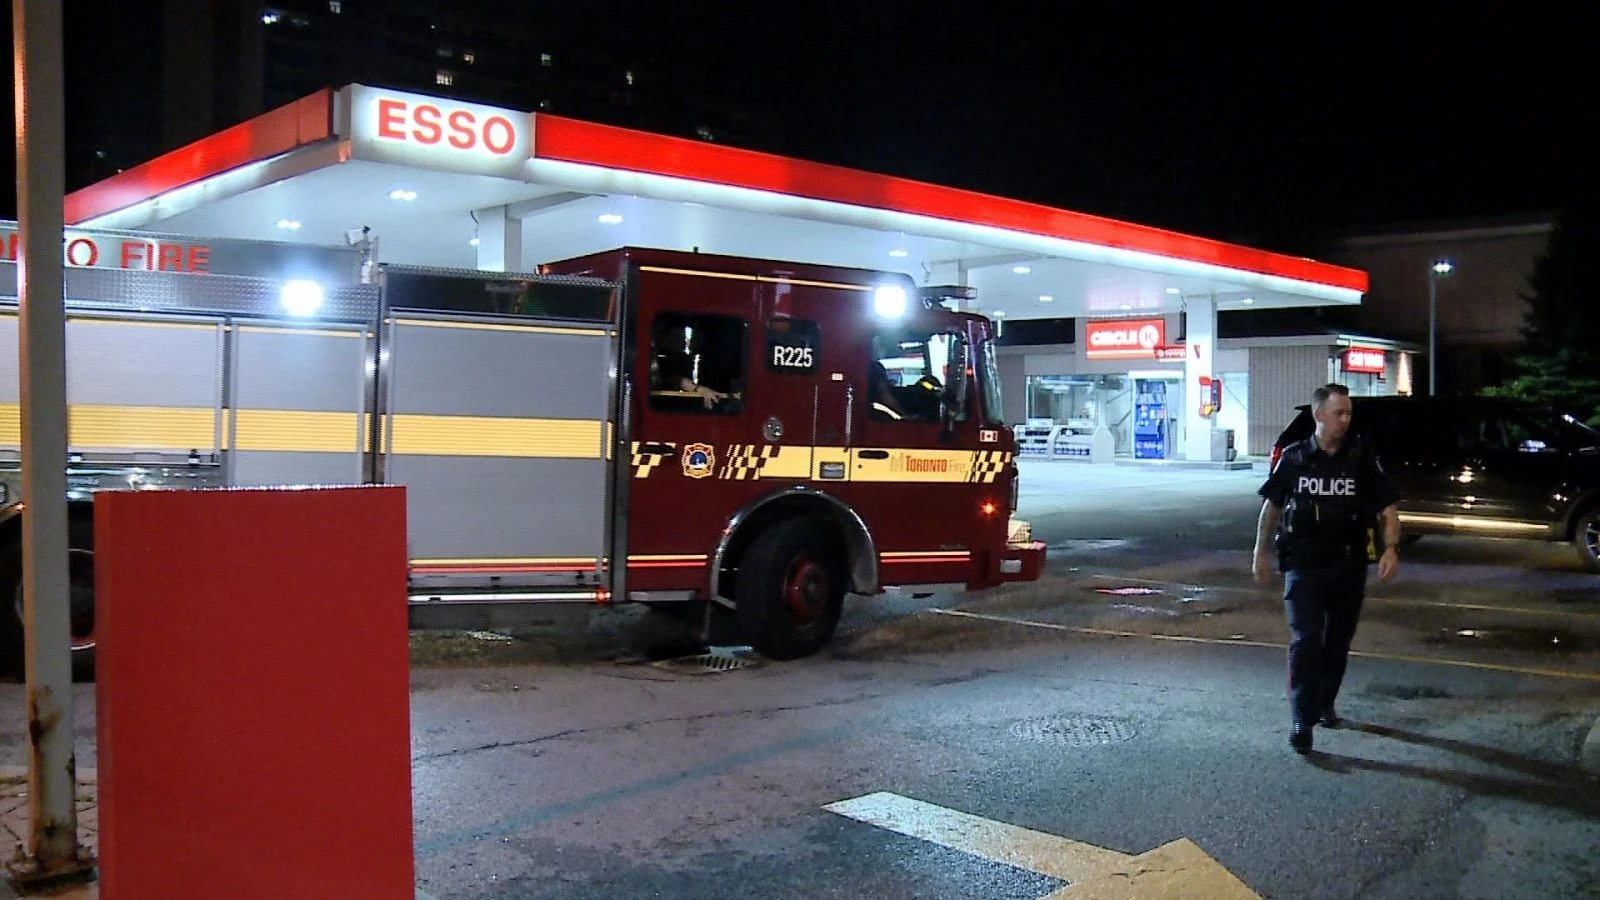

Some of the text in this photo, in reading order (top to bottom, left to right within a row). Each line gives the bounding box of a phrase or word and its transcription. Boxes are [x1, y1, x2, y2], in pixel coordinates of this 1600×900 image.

[378, 98, 516, 155] ESSO
[121, 240, 209, 275] FIRE
[773, 345, 813, 368] R225
[905, 455, 948, 473] TORONTO
[1298, 475, 1356, 496] POLICE
